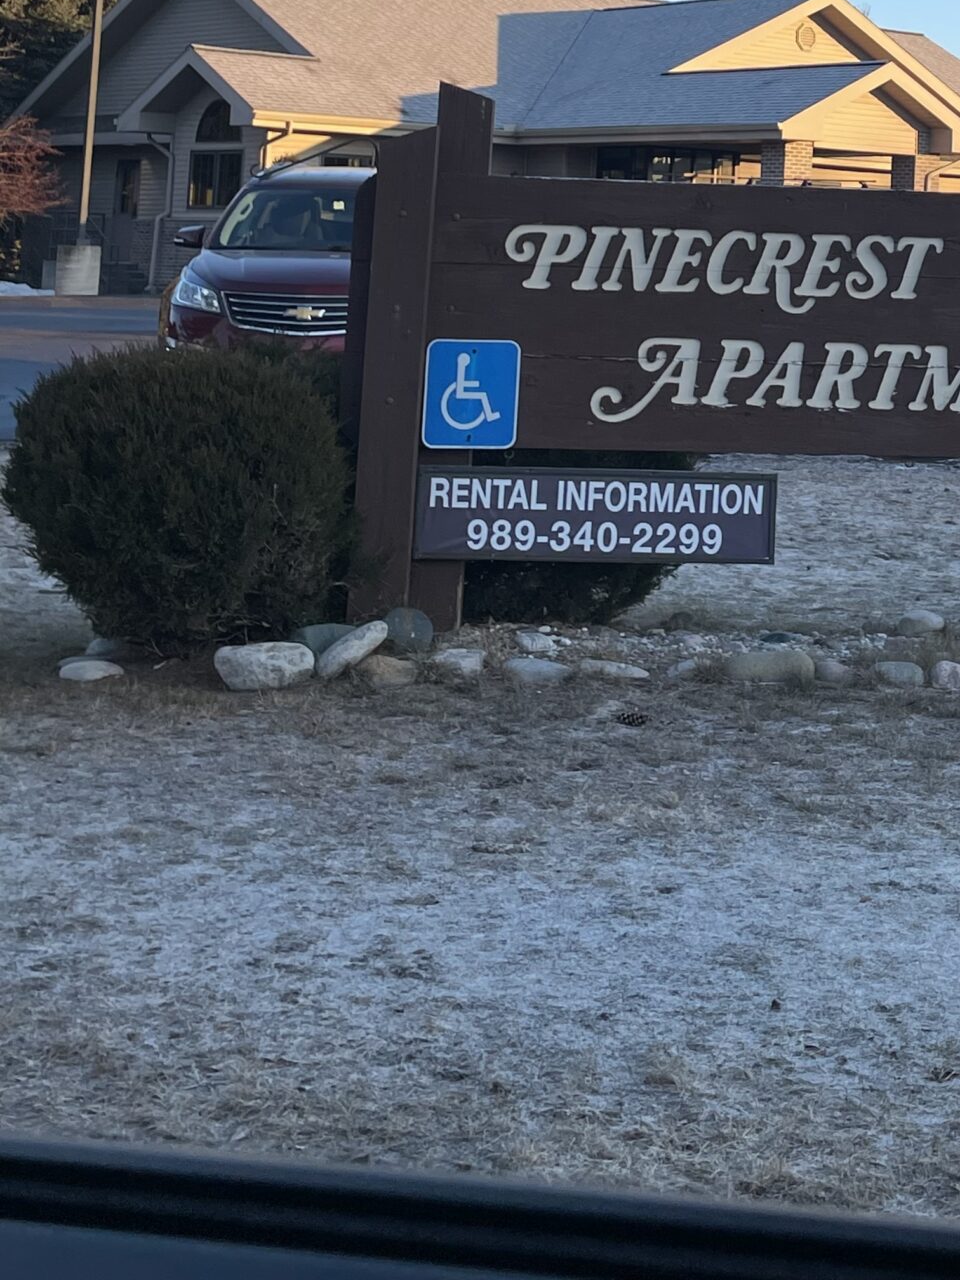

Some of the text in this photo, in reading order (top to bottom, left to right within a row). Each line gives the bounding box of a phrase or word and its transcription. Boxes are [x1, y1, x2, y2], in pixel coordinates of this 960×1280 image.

[504, 224, 944, 314] PINECREST
[429, 477, 764, 515] RENTAL INFORMATION
[467, 519, 723, 555] 989-340-2299
